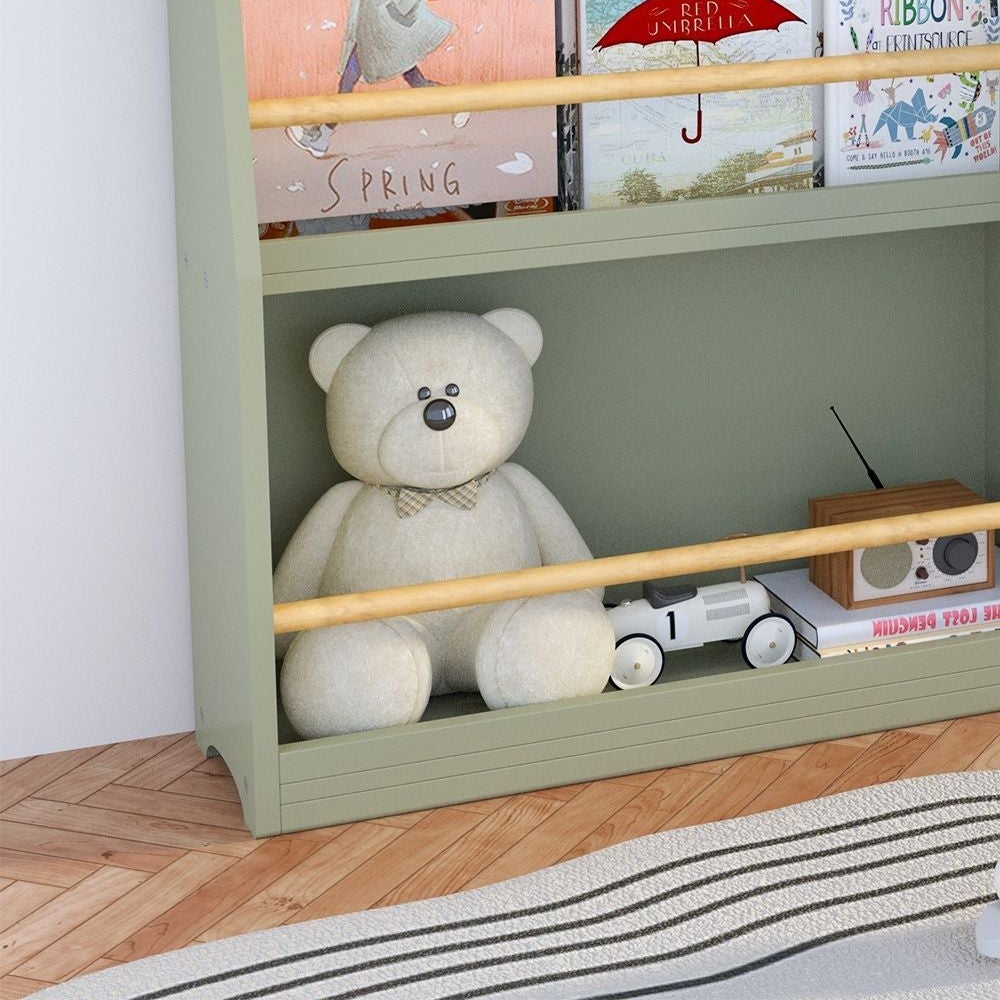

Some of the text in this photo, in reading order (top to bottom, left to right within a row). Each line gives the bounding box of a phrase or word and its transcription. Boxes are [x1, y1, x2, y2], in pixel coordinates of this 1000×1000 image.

[681, 0, 719, 18] RED
[647, 13, 754, 36] UMBRELLA
[886, 29, 973, 53] PRINTSOURCE
[620, 150, 668, 166] CUBA
[321, 157, 461, 214] SPRING
[665, 610, 676, 641] 1
